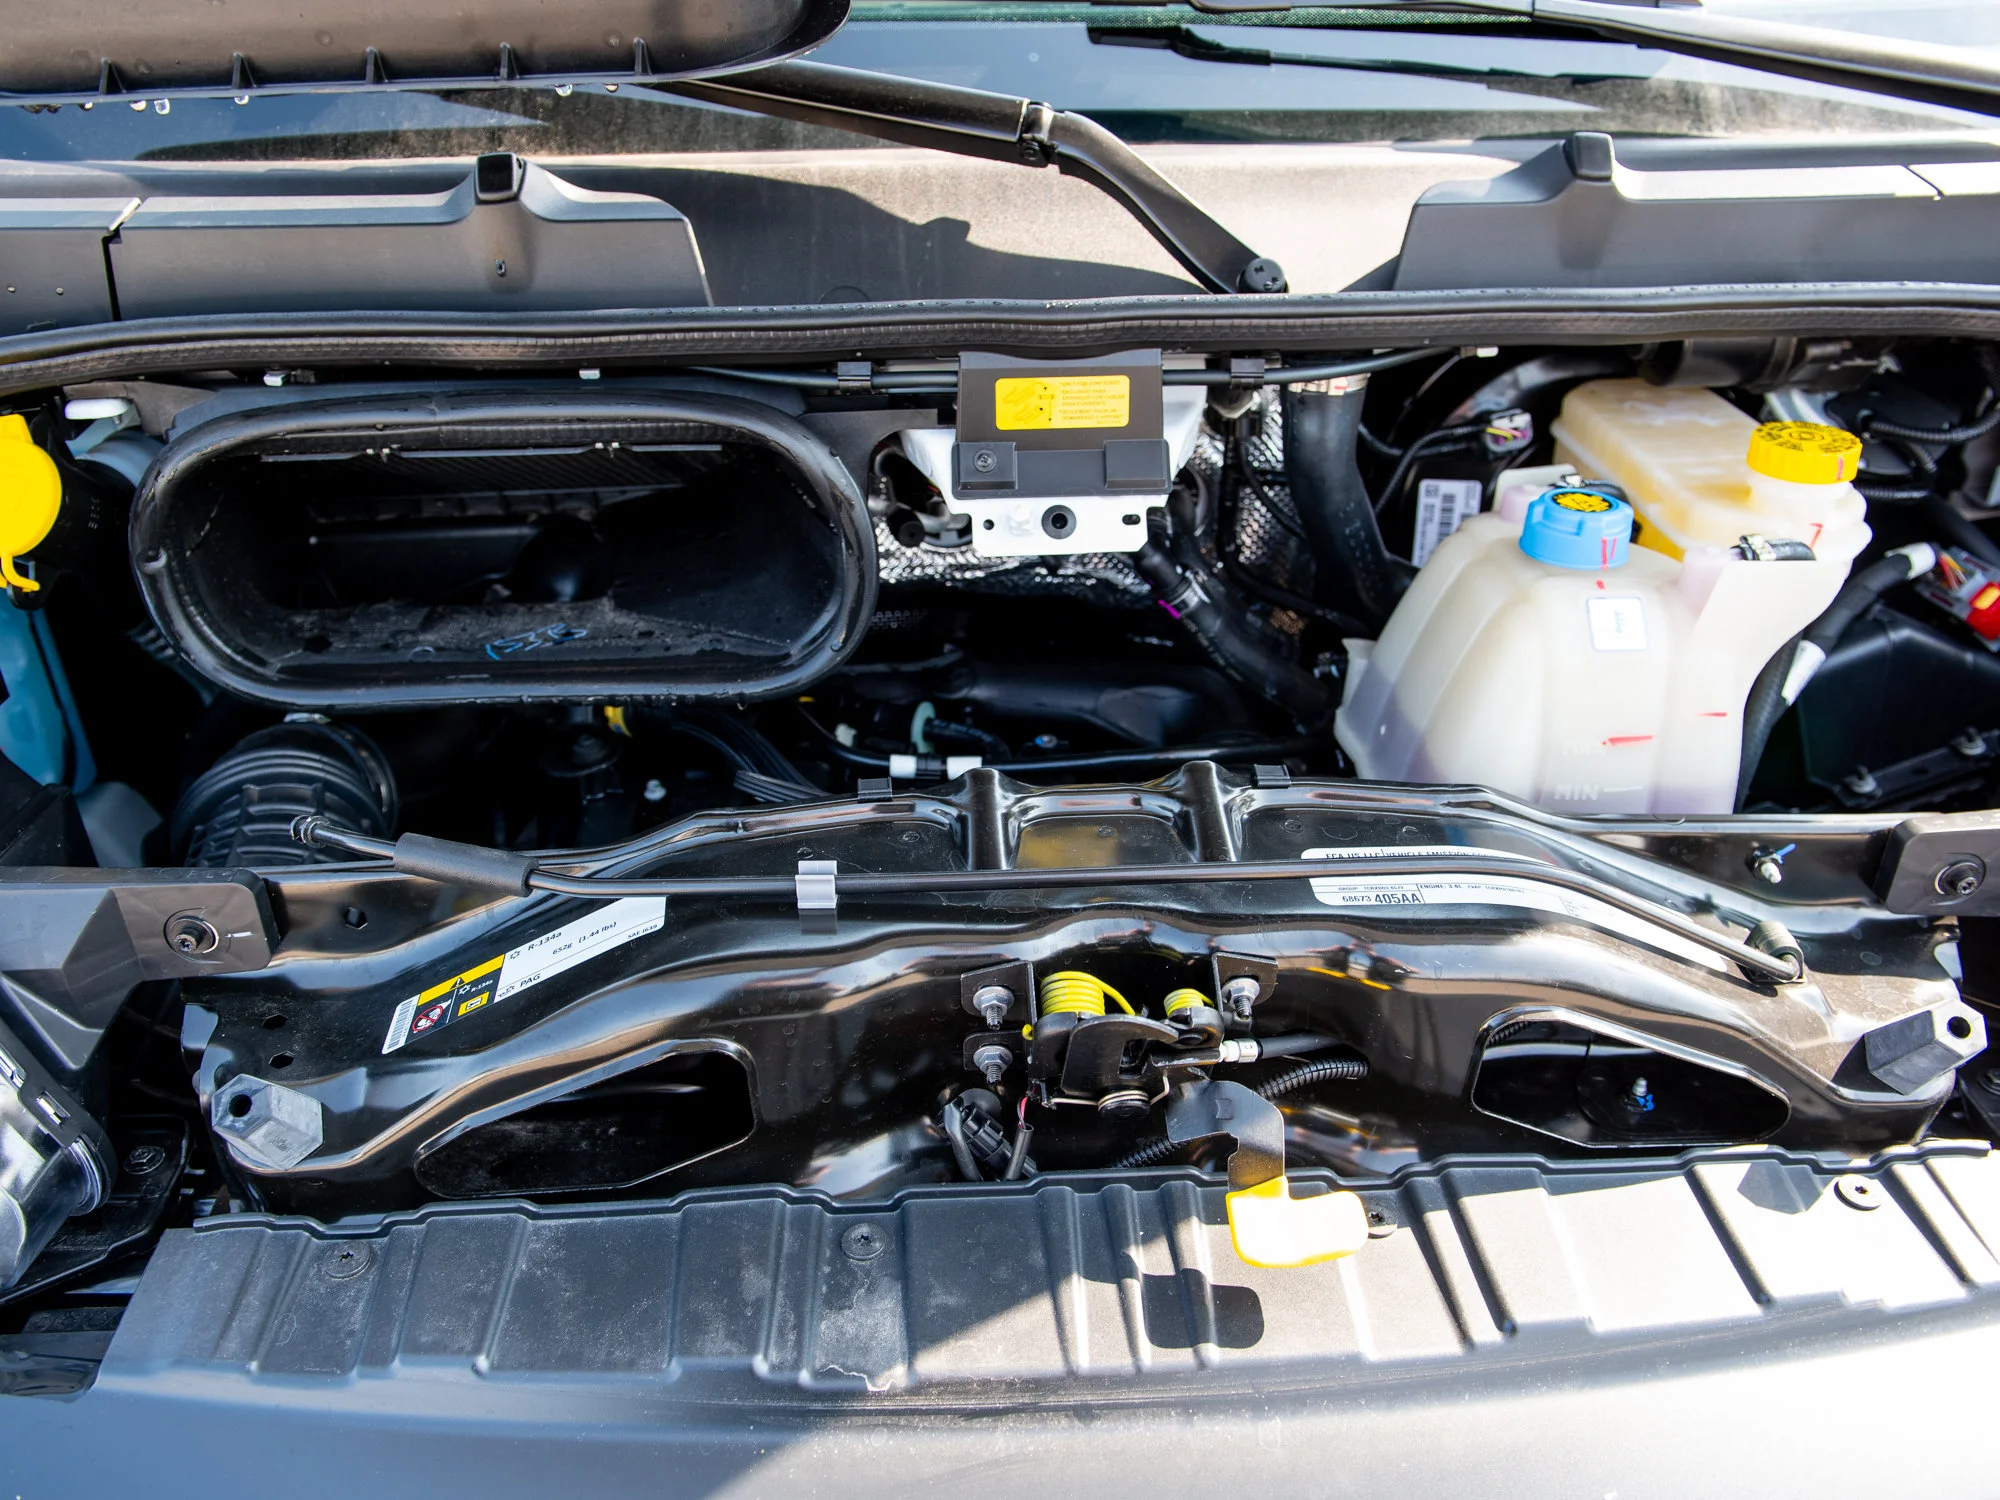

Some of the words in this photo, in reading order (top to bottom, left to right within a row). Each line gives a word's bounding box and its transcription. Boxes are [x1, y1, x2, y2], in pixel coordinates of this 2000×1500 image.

[1554, 783, 1599, 801] MIN
[1342, 895, 1372, 903] 68673
[1374, 892, 1421, 905] 405AA
[527, 931, 562, 951] R-134a
[627, 930, 641, 939] SAE
[519, 973, 542, 988] PAG
